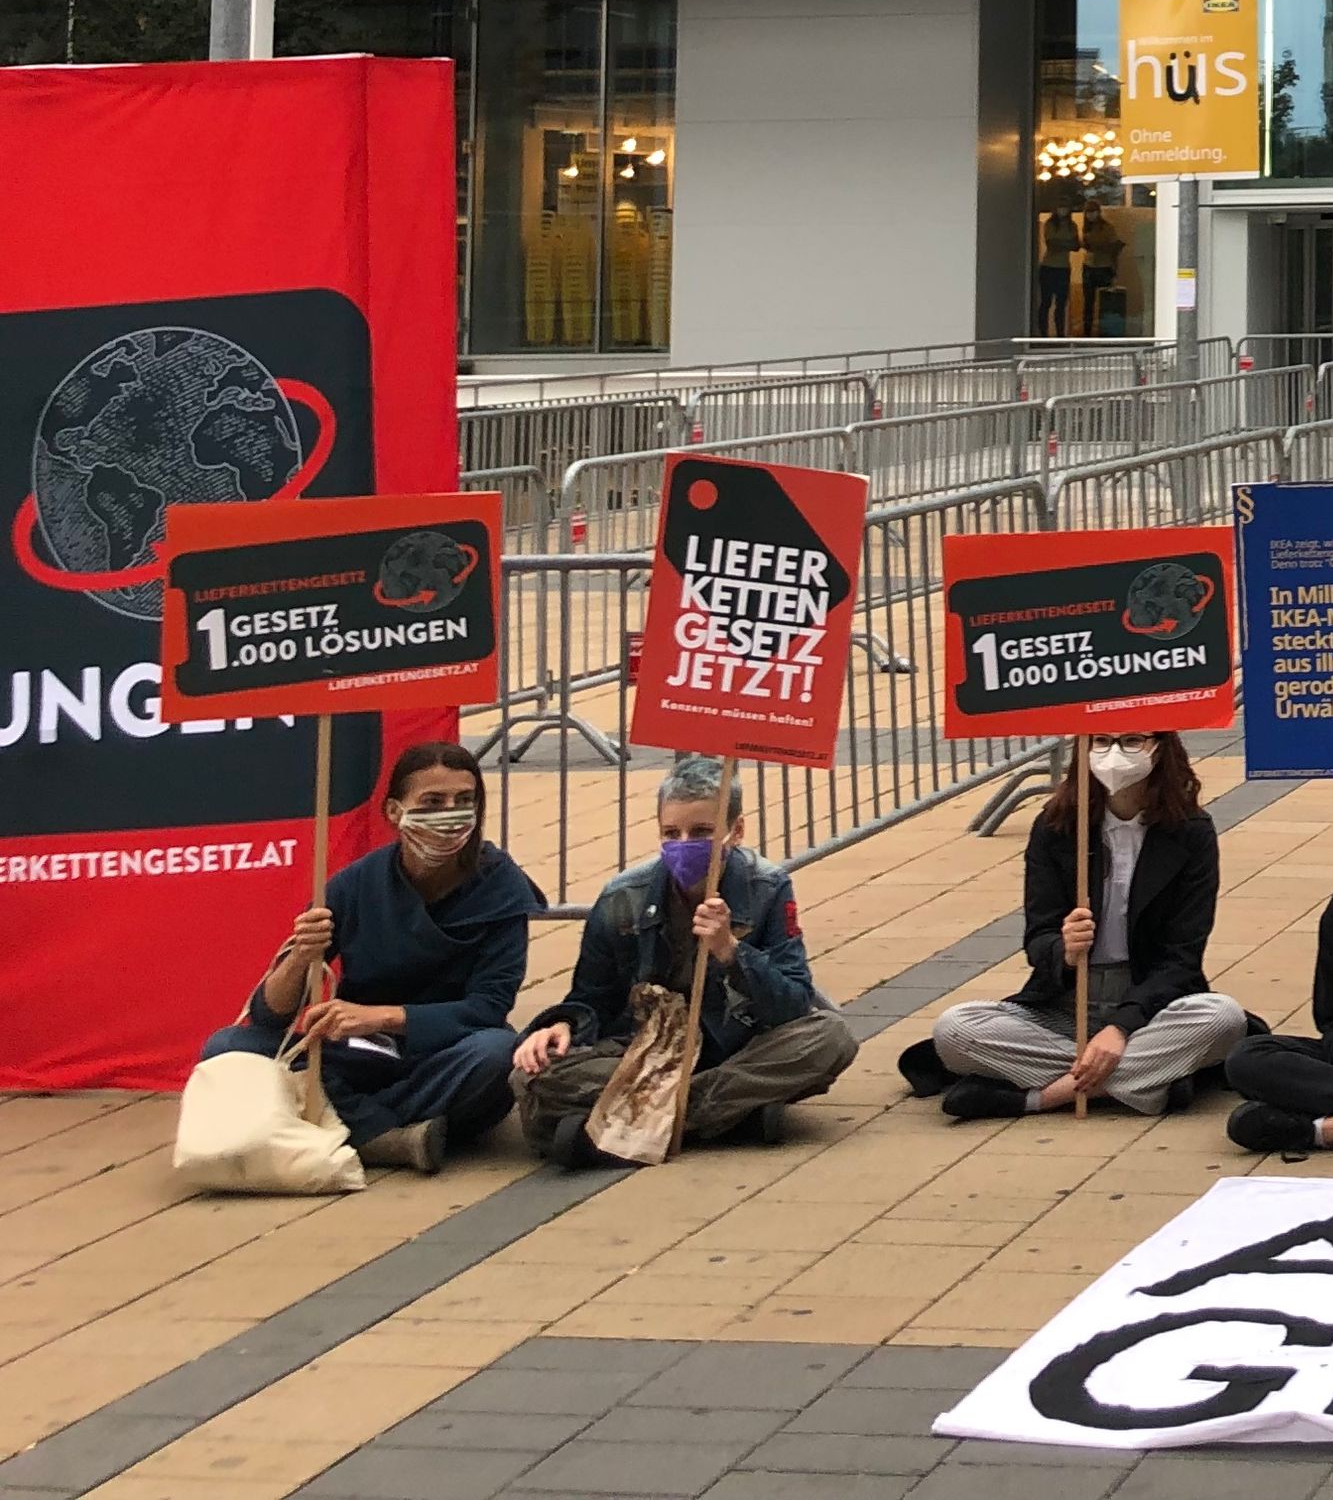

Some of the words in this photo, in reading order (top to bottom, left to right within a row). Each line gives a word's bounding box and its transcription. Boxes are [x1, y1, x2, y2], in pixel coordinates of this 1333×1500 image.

[1206, 1, 1236, 10] IKEA
[1127, 40, 1247, 104] hüs
[1130, 129, 1172, 144] Ohne
[1130, 147, 1227, 164] Anmeldung.
[684, 535, 829, 587] LIEFER
[194, 570, 366, 602] LIEFERKETTENGESETZ
[680, 574, 830, 626] KETTEN
[1269, 586, 1292, 605] In
[230, 604, 338, 637] GESETZ
[969, 599, 1115, 627] LIEFERKETTENGESETZ
[305, 617, 467, 657] LÖSUNGEN
[674, 613, 827, 664] GESETZ
[1000, 631, 1093, 660] GESETZ
[329, 663, 478, 691] LIEFERKETTENGESETZ.AT
[666, 651, 815, 703] JETZT!
[1065, 645, 1206, 681] LÖSUNGEN
[1273, 656, 1311, 673] aus
[0, 662, 296, 747] UNG
[660, 699, 718, 716] Konzerne
[721, 708, 766, 721] müssen
[769, 711, 813, 727] haften!
[1086, 689, 1216, 713] LIEFERKETTENGESETZ.AT
